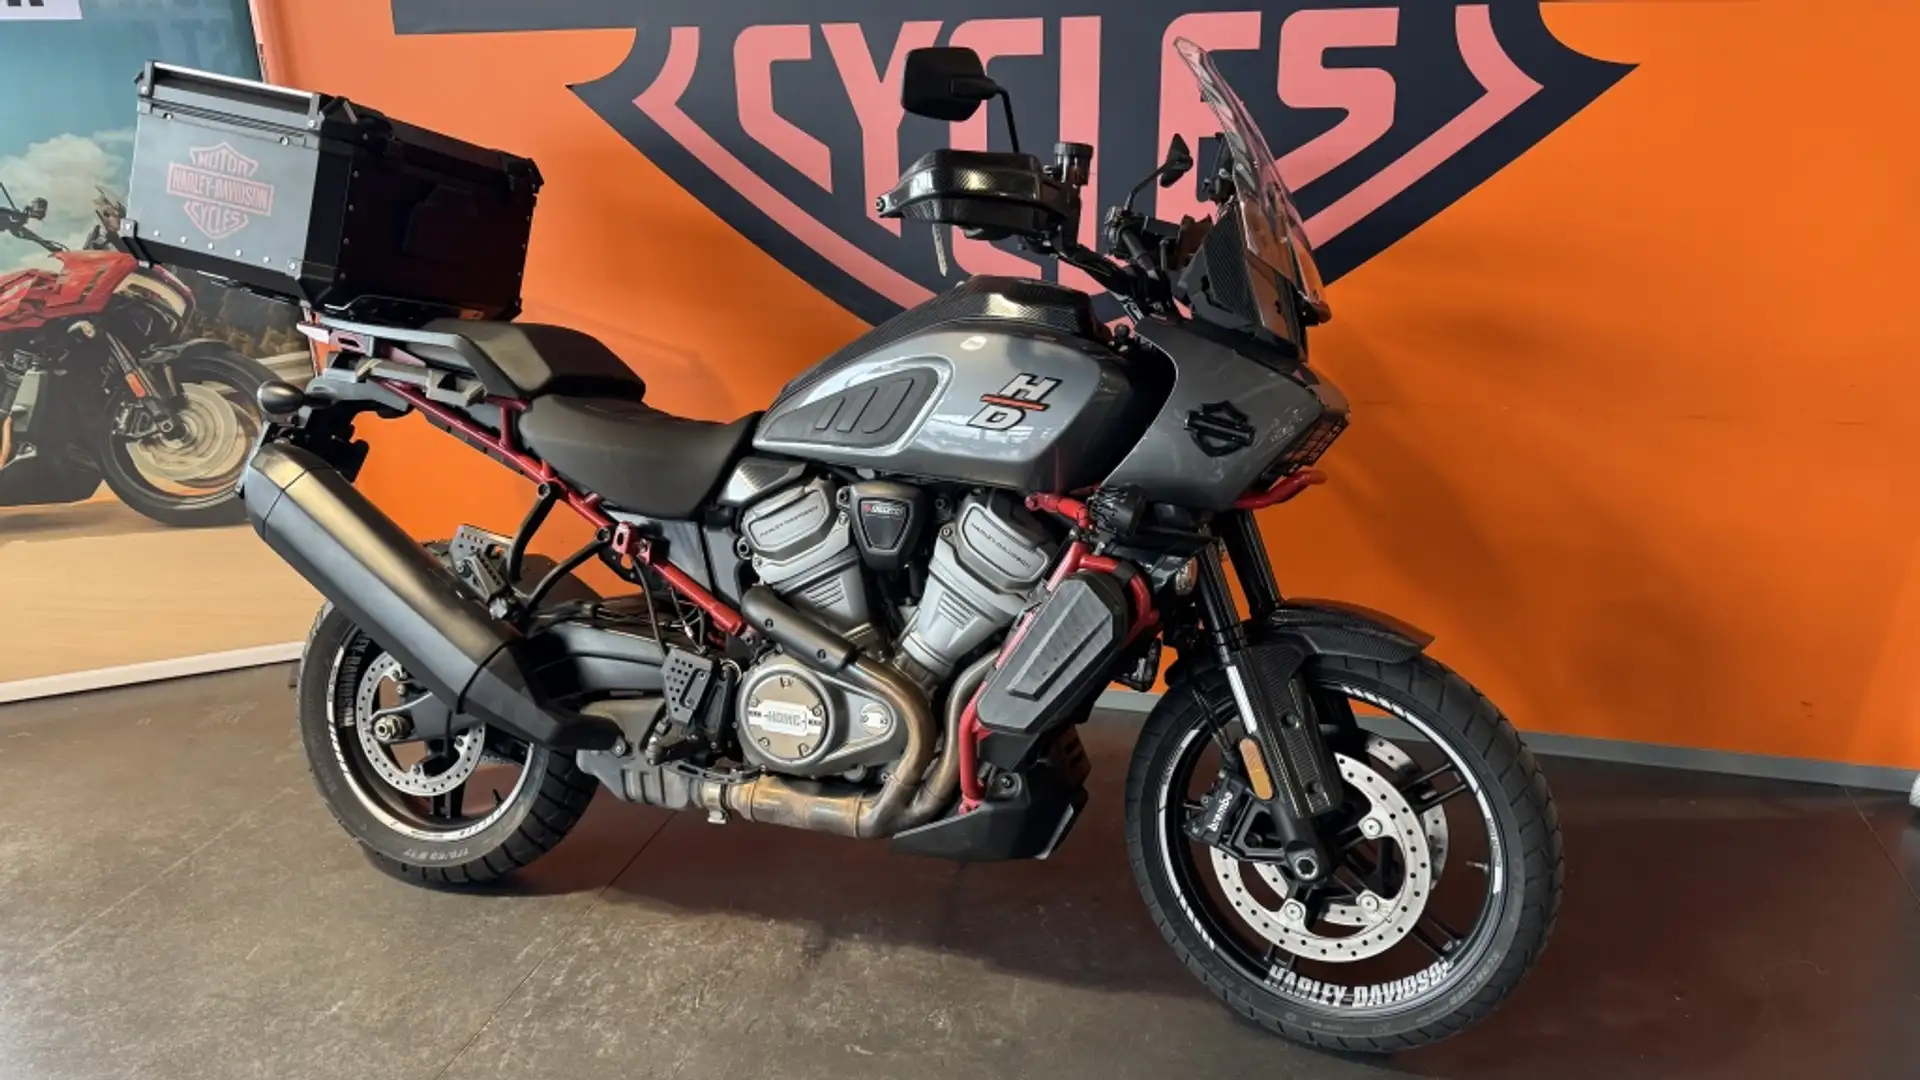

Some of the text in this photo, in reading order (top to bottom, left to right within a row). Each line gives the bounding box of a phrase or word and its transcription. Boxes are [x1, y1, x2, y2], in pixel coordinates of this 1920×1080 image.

[197, 147, 249, 178] MOTOR
[171, 166, 270, 211] HARLEY-DAVIDSON
[190, 201, 242, 234] CYCLES
[1207, 791, 1234, 832] brembo
